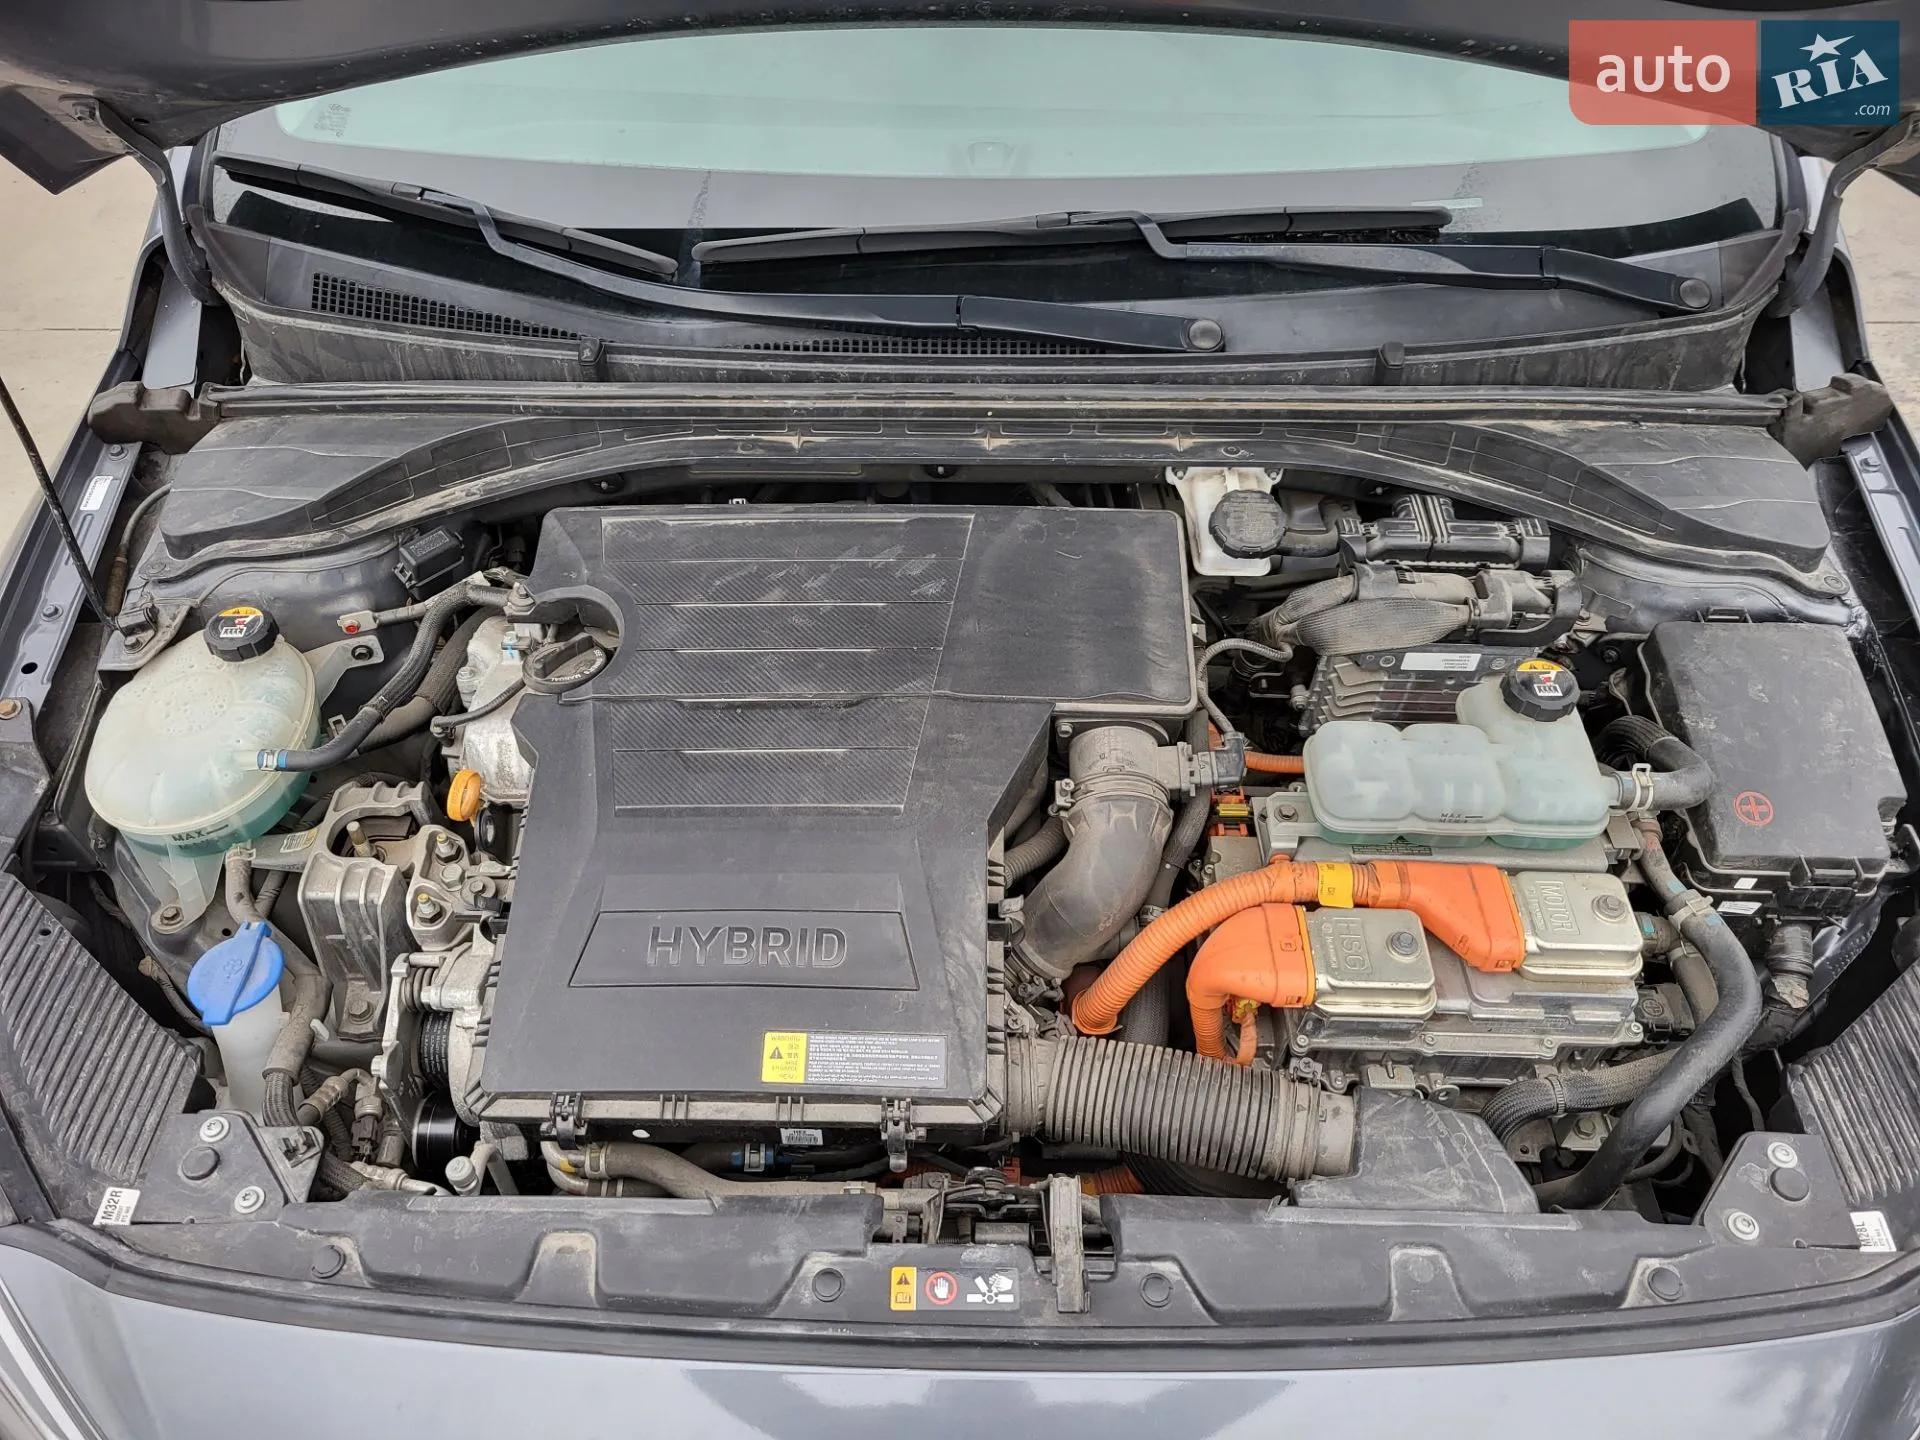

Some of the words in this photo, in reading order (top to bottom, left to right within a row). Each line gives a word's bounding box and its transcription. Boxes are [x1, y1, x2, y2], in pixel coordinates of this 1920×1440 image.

[171, 829, 205, 842] MAX
[1540, 885, 1574, 932] MOTOR
[647, 925, 847, 969] HYBRID
[1334, 921, 1368, 971] HSG
[101, 1190, 123, 1220] M32R
